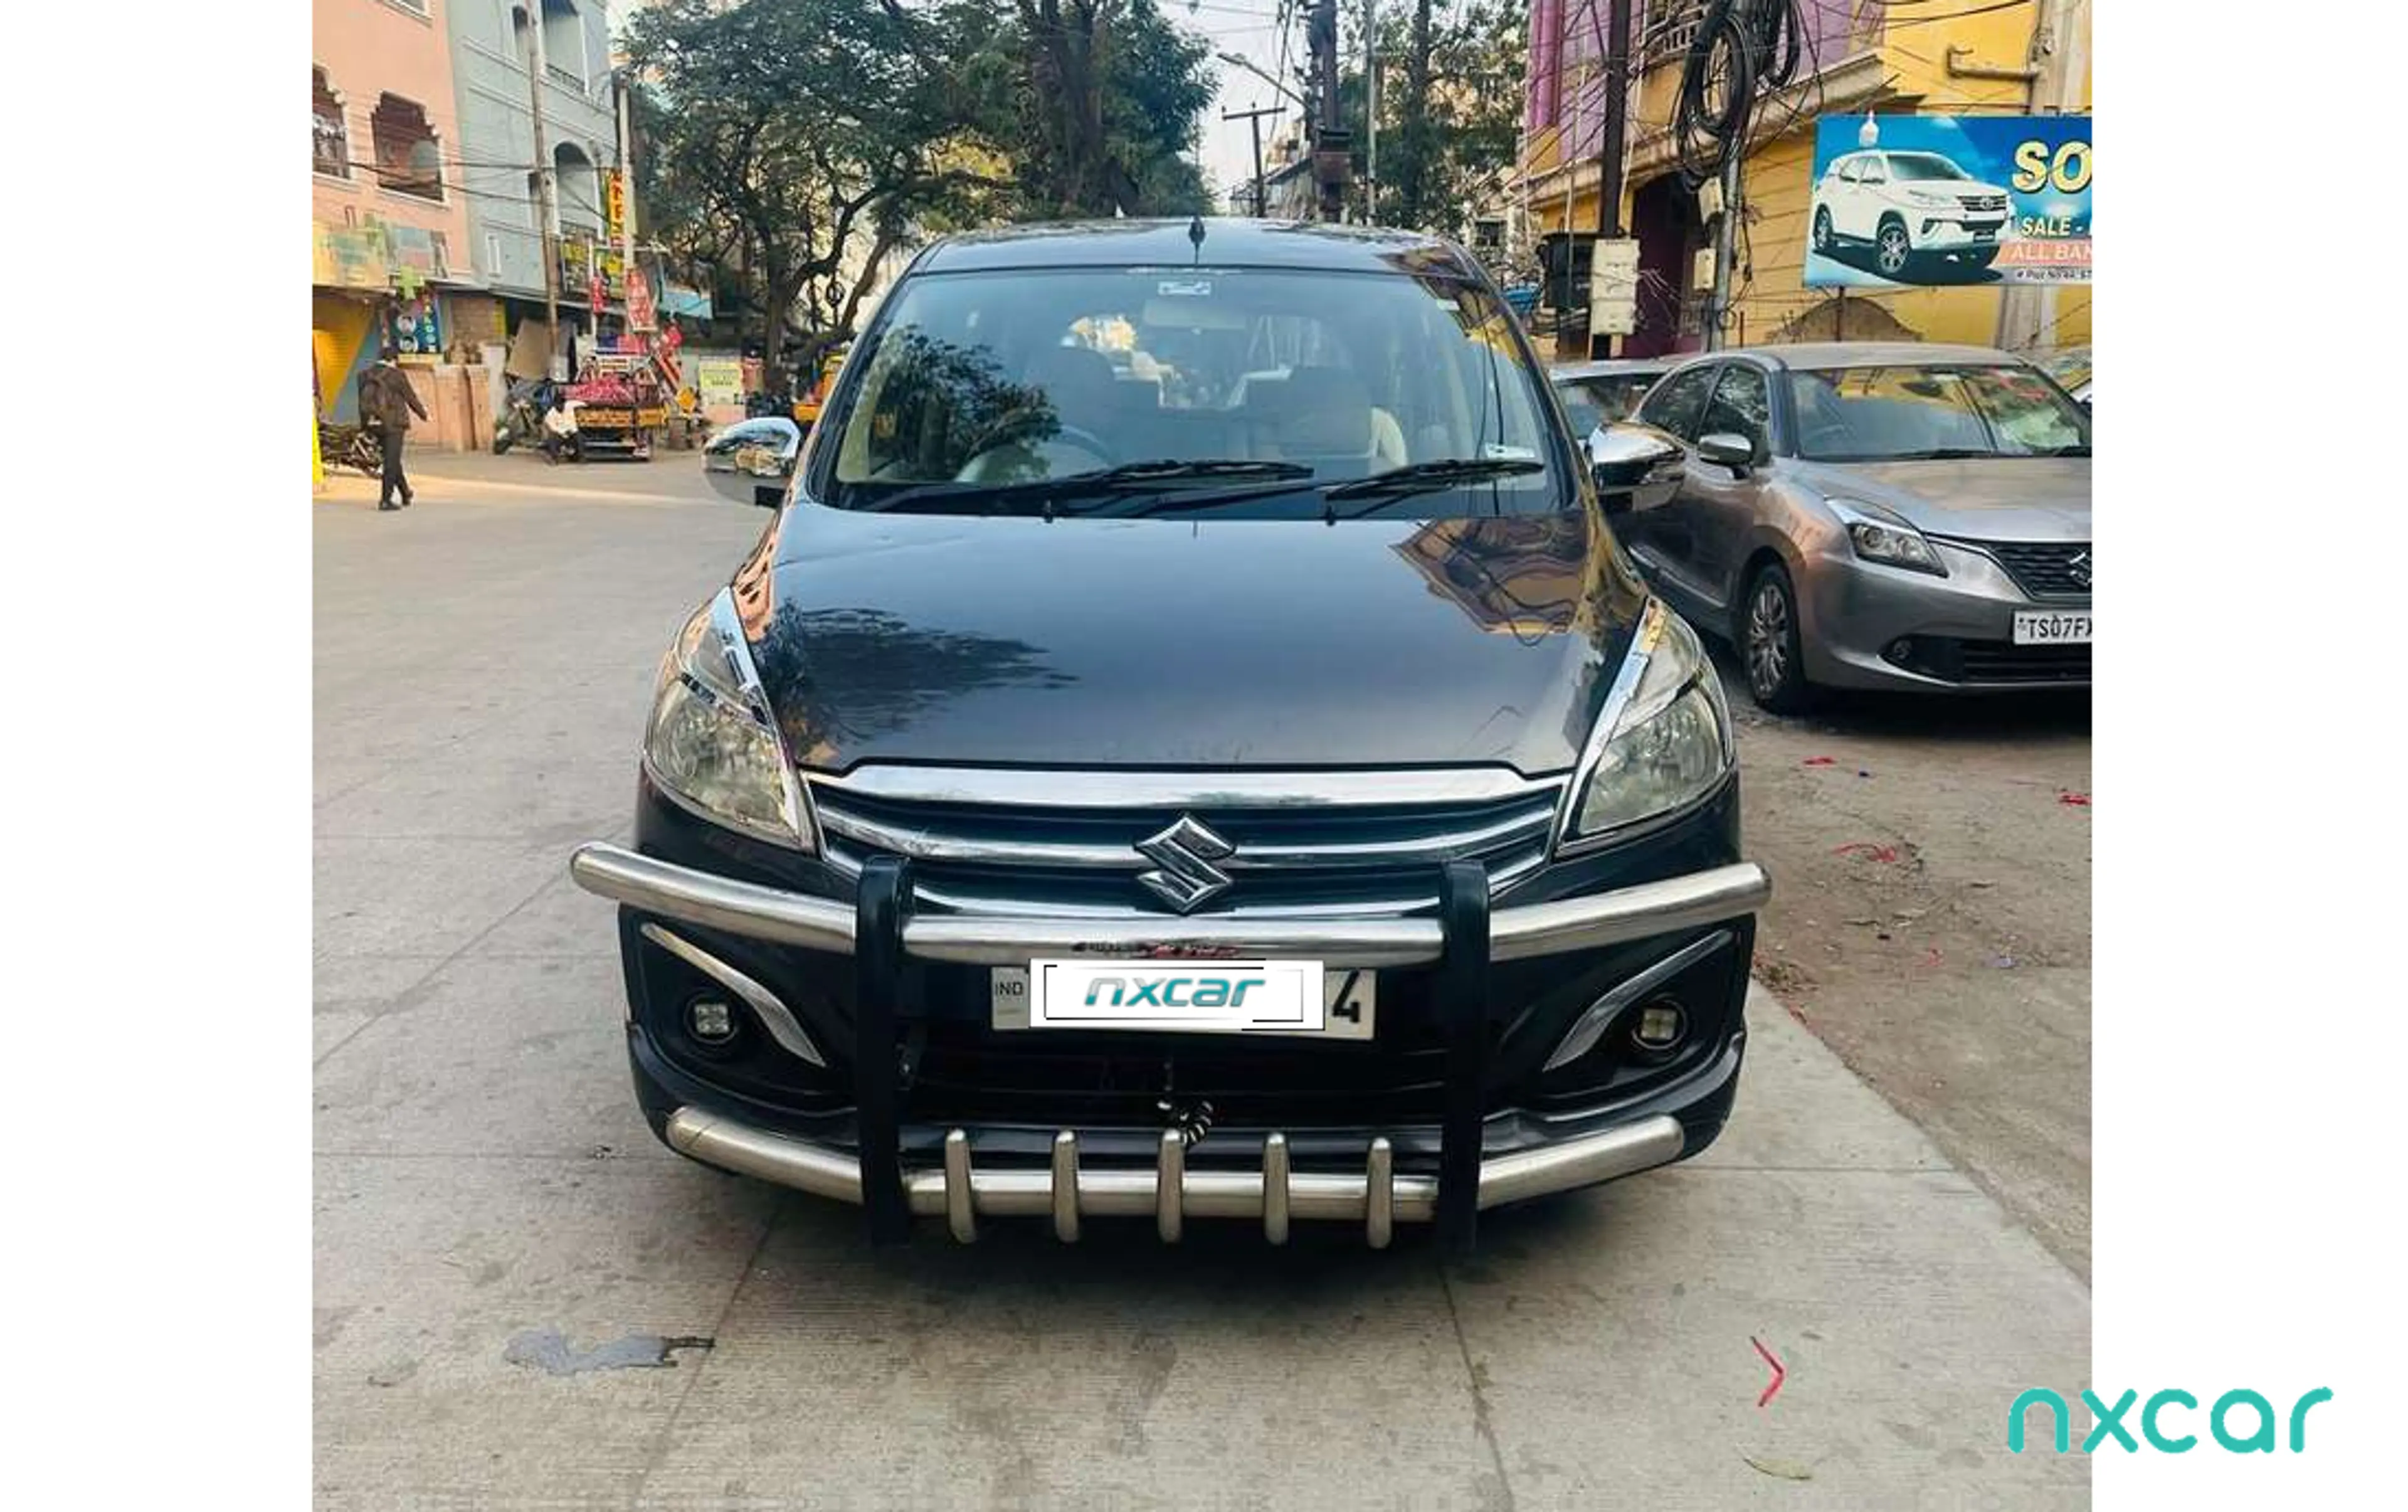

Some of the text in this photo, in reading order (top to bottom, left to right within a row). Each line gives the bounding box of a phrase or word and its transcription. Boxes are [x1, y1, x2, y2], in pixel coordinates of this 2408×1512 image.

[2020, 216, 2071, 236] SALE
[2010, 243, 2050, 260] ALL
[995, 981, 1023, 996] IND
[1332, 969, 1361, 1024] 4
